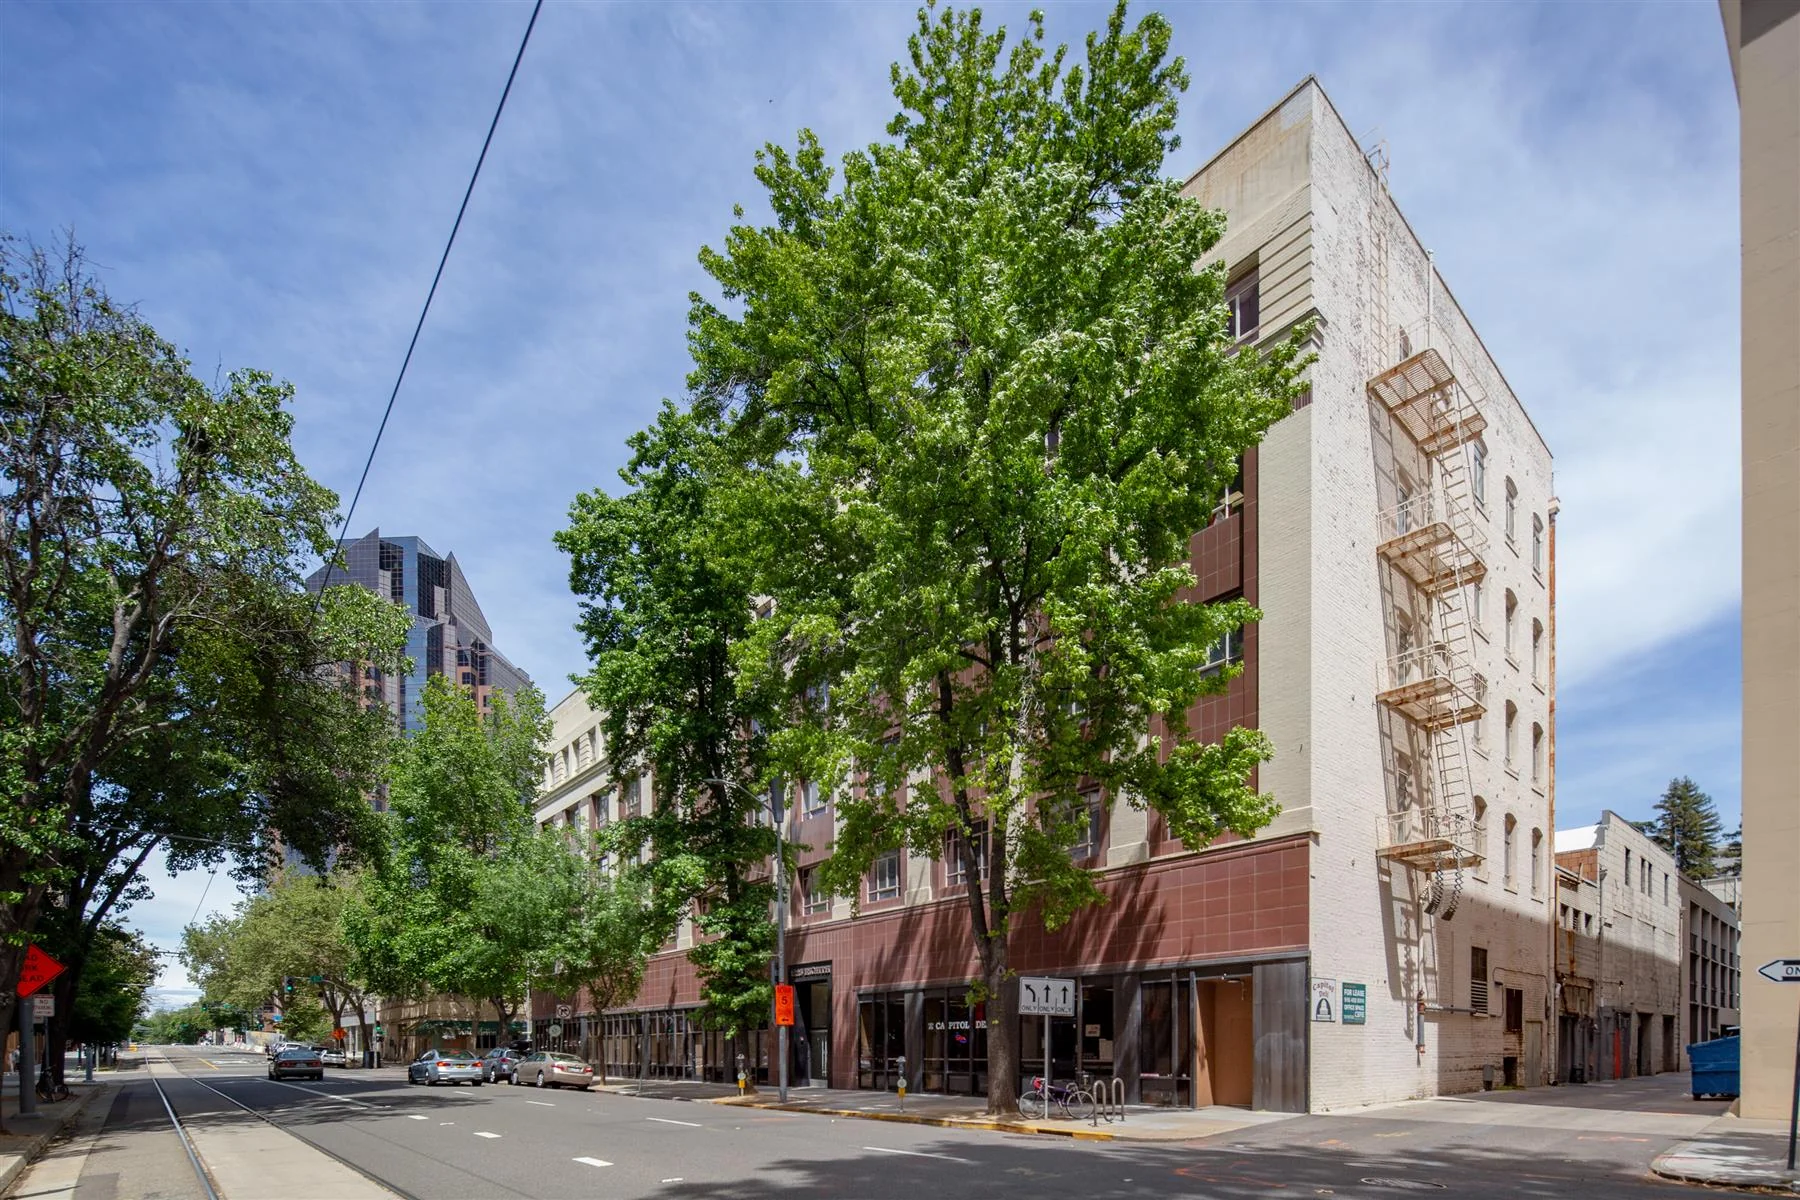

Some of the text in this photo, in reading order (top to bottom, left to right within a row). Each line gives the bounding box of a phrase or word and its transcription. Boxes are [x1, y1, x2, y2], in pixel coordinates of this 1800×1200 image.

[1786, 966, 1800, 976] ON
[1343, 988, 1352, 997] FOR
[781, 996, 788, 1005] 5
[1021, 1004, 1038, 1012] ONLY
[1040, 1005, 1054, 1013] ONLY
[975, 1020, 987, 1029] DE
